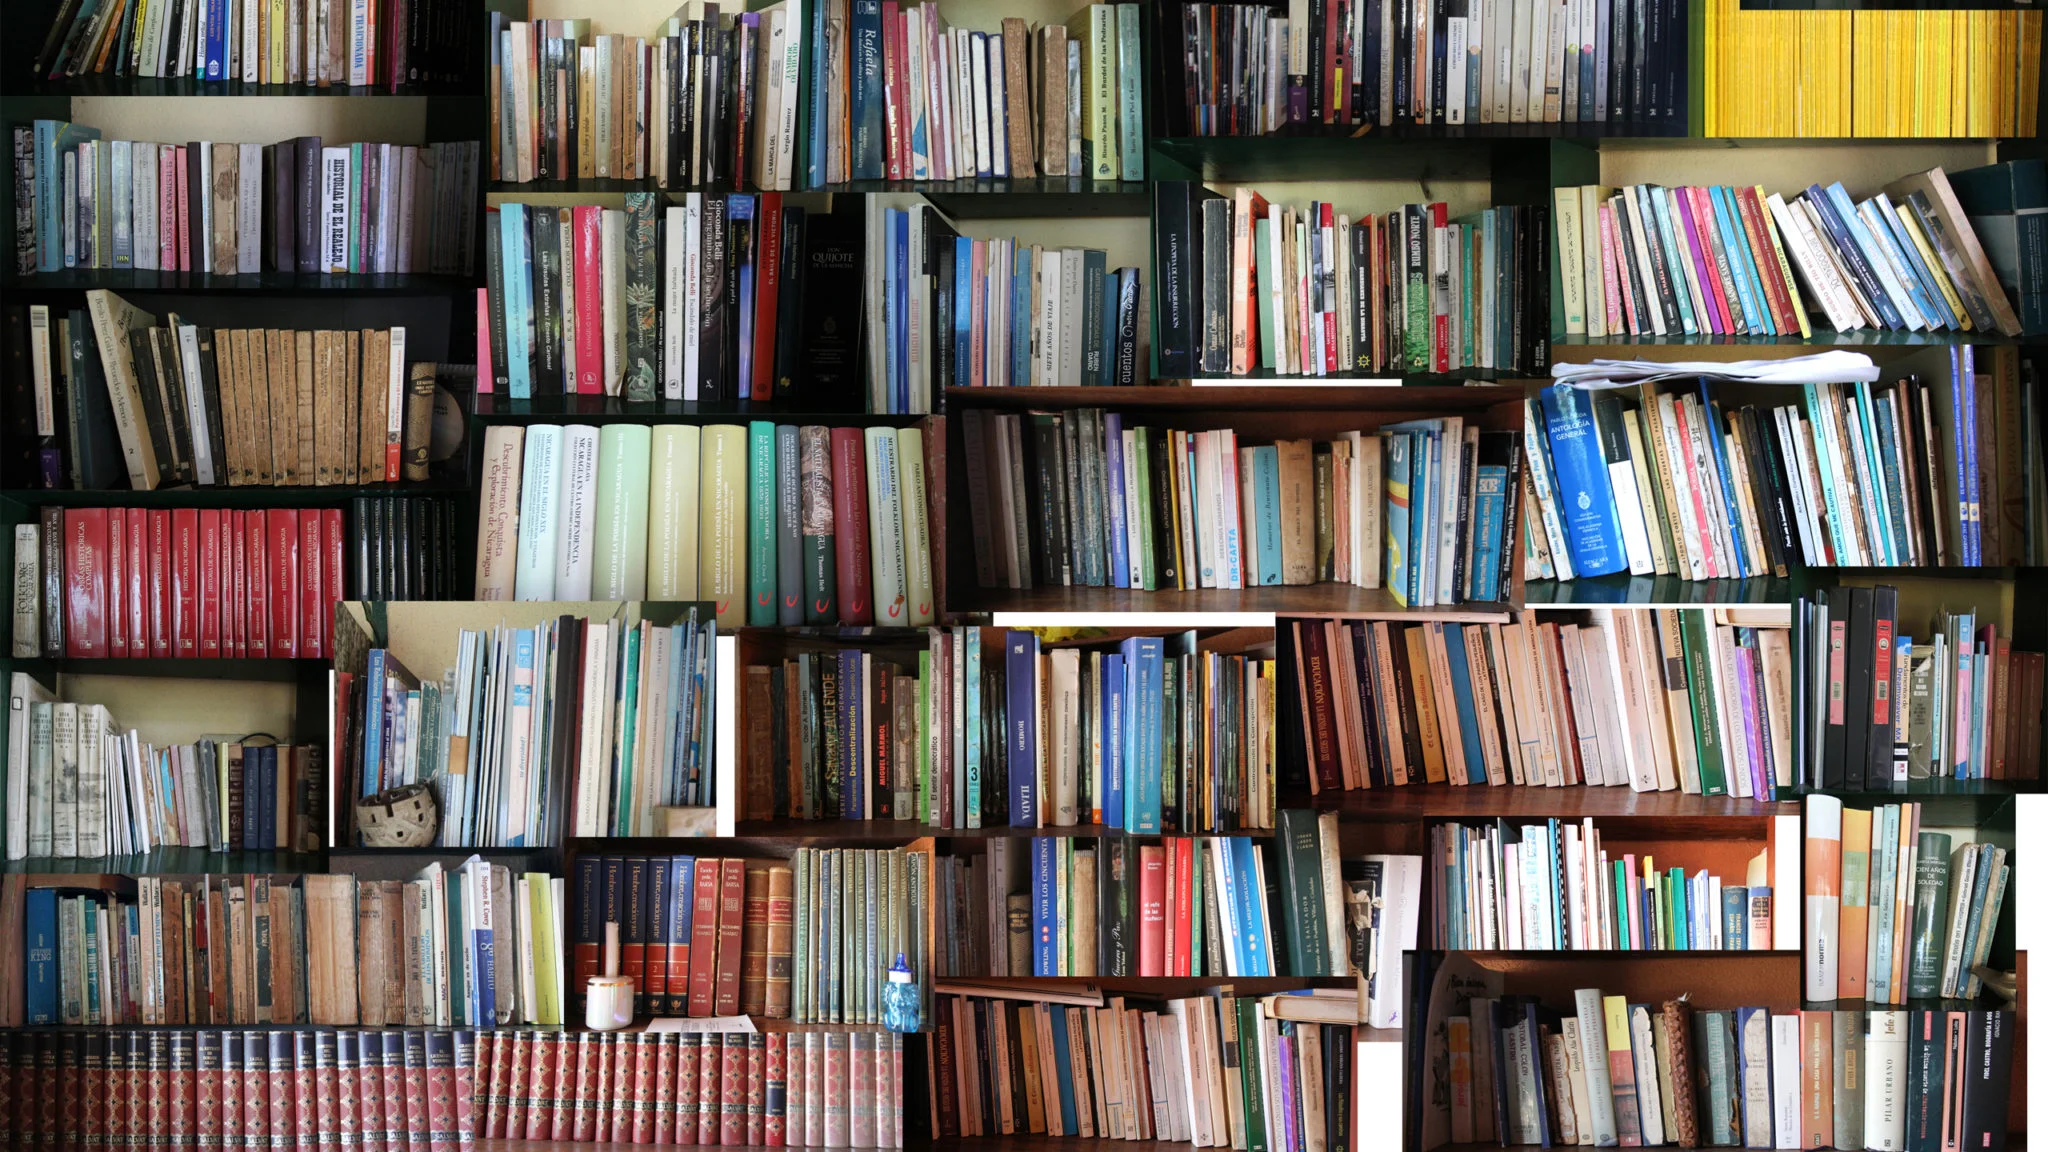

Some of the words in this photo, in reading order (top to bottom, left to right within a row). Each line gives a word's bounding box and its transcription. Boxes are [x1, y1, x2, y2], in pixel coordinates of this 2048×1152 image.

[354, 20, 363, 68] TRAICIONADA
[863, 29, 876, 76] Rafaela
[334, 159, 345, 200] HISTORIAL
[333, 204, 344, 213] DE
[707, 200, 715, 208] El
[332, 217, 344, 227] EL
[714, 200, 723, 239] Gioconda
[1410, 216, 1420, 239] NORTE
[332, 228, 344, 263] REALEJO
[704, 212, 715, 259] pergamino
[714, 242, 723, 260] Belli
[812, 252, 854, 263] QUIJOTE
[1410, 241, 1420, 266] RUMBO
[705, 263, 714, 272] de
[705, 286, 714, 326] seducción
[1120, 342, 1133, 383] cuentos
[1551, 420, 1590, 434] ANTOLOGÍA
[1556, 430, 1587, 441] GENERAL
[543, 434, 552, 474] NICARAGUA
[577, 438, 585, 479] NICARAGUA
[543, 476, 550, 486] EN
[576, 480, 583, 490] EN
[575, 491, 582, 501] LA
[1827, 487, 1836, 512] CAUTIVA
[572, 502, 581, 564] INDEPENDENCIA
[1228, 529, 1239, 582] DR-CAFTA
[1670, 609, 1679, 635] SOCIEDA
[1672, 636, 1681, 656] NUEVA
[372, 667, 381, 696] Relaciones
[822, 673, 836, 728] ALLENDE
[371, 698, 380, 730] Económicas
[1782, 714, 1790, 740] Historia
[878, 724, 886, 757] MÁRMOL
[824, 731, 837, 779] Salvador
[970, 767, 978, 781] 3
[1020, 785, 1030, 819] ILIADA
[1916, 866, 1928, 874] CIEN
[1930, 866, 1946, 874] AÑOS
[1112, 921, 1121, 940] Paz
[1209, 908, 1218, 940] fundadores
[1302, 896, 1311, 939] SALVADOR
[1210, 941, 1219, 961] padres
[1567, 1021, 1576, 1038] Clarín
[1884, 1020, 1895, 1035] Jefe
[1885, 1059, 1893, 1094] URBANO
[1884, 1098, 1893, 1122] PILAR
